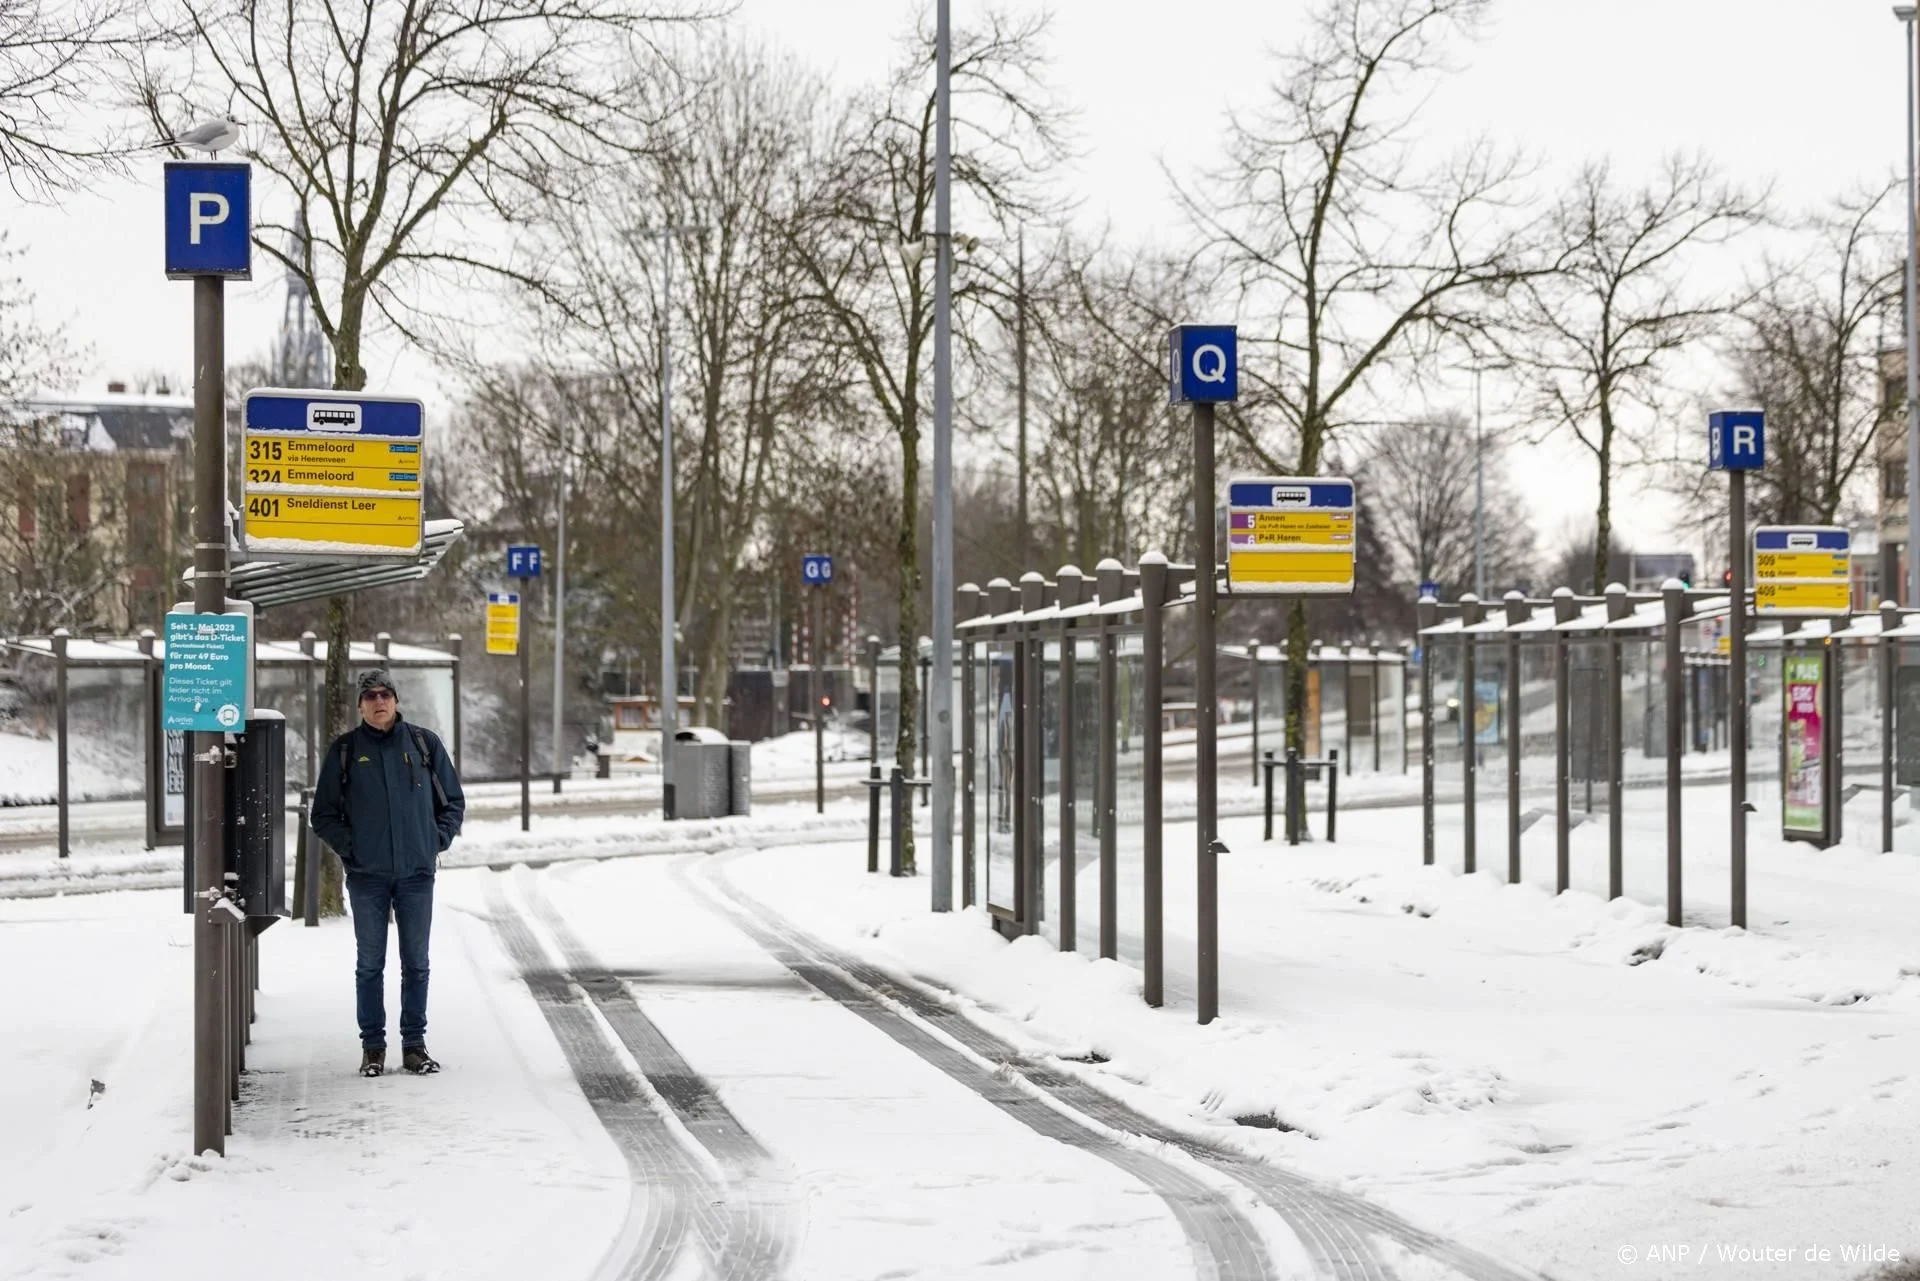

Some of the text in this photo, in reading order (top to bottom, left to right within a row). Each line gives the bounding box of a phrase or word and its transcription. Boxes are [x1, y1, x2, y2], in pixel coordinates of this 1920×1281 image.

[190, 192, 230, 245] P
[1192, 344, 1227, 384] Q
[1733, 425, 1756, 455] R
[250, 440, 282, 461] 315
[287, 440, 355, 453] Emmeloord
[301, 455, 346, 464] Heerenveen
[287, 469, 355, 481] Emmeloord
[249, 498, 377, 518] 401 Sneldienst Leer
[1247, 514, 1256, 529] 5
[1277, 533, 1302, 541] Haren
[512, 552, 523, 571] F
[529, 552, 538, 571] F
[806, 560, 819, 578] G
[170, 622, 235, 632] Seit 1. Mai 2023
[170, 633, 246, 642] gibt's das D-Ticket
[169, 652, 183, 660] für
[198, 652, 209, 660] 49
[185, 662, 214, 671] Monat.
[169, 677, 233, 688] Dieses Ticket gilt
